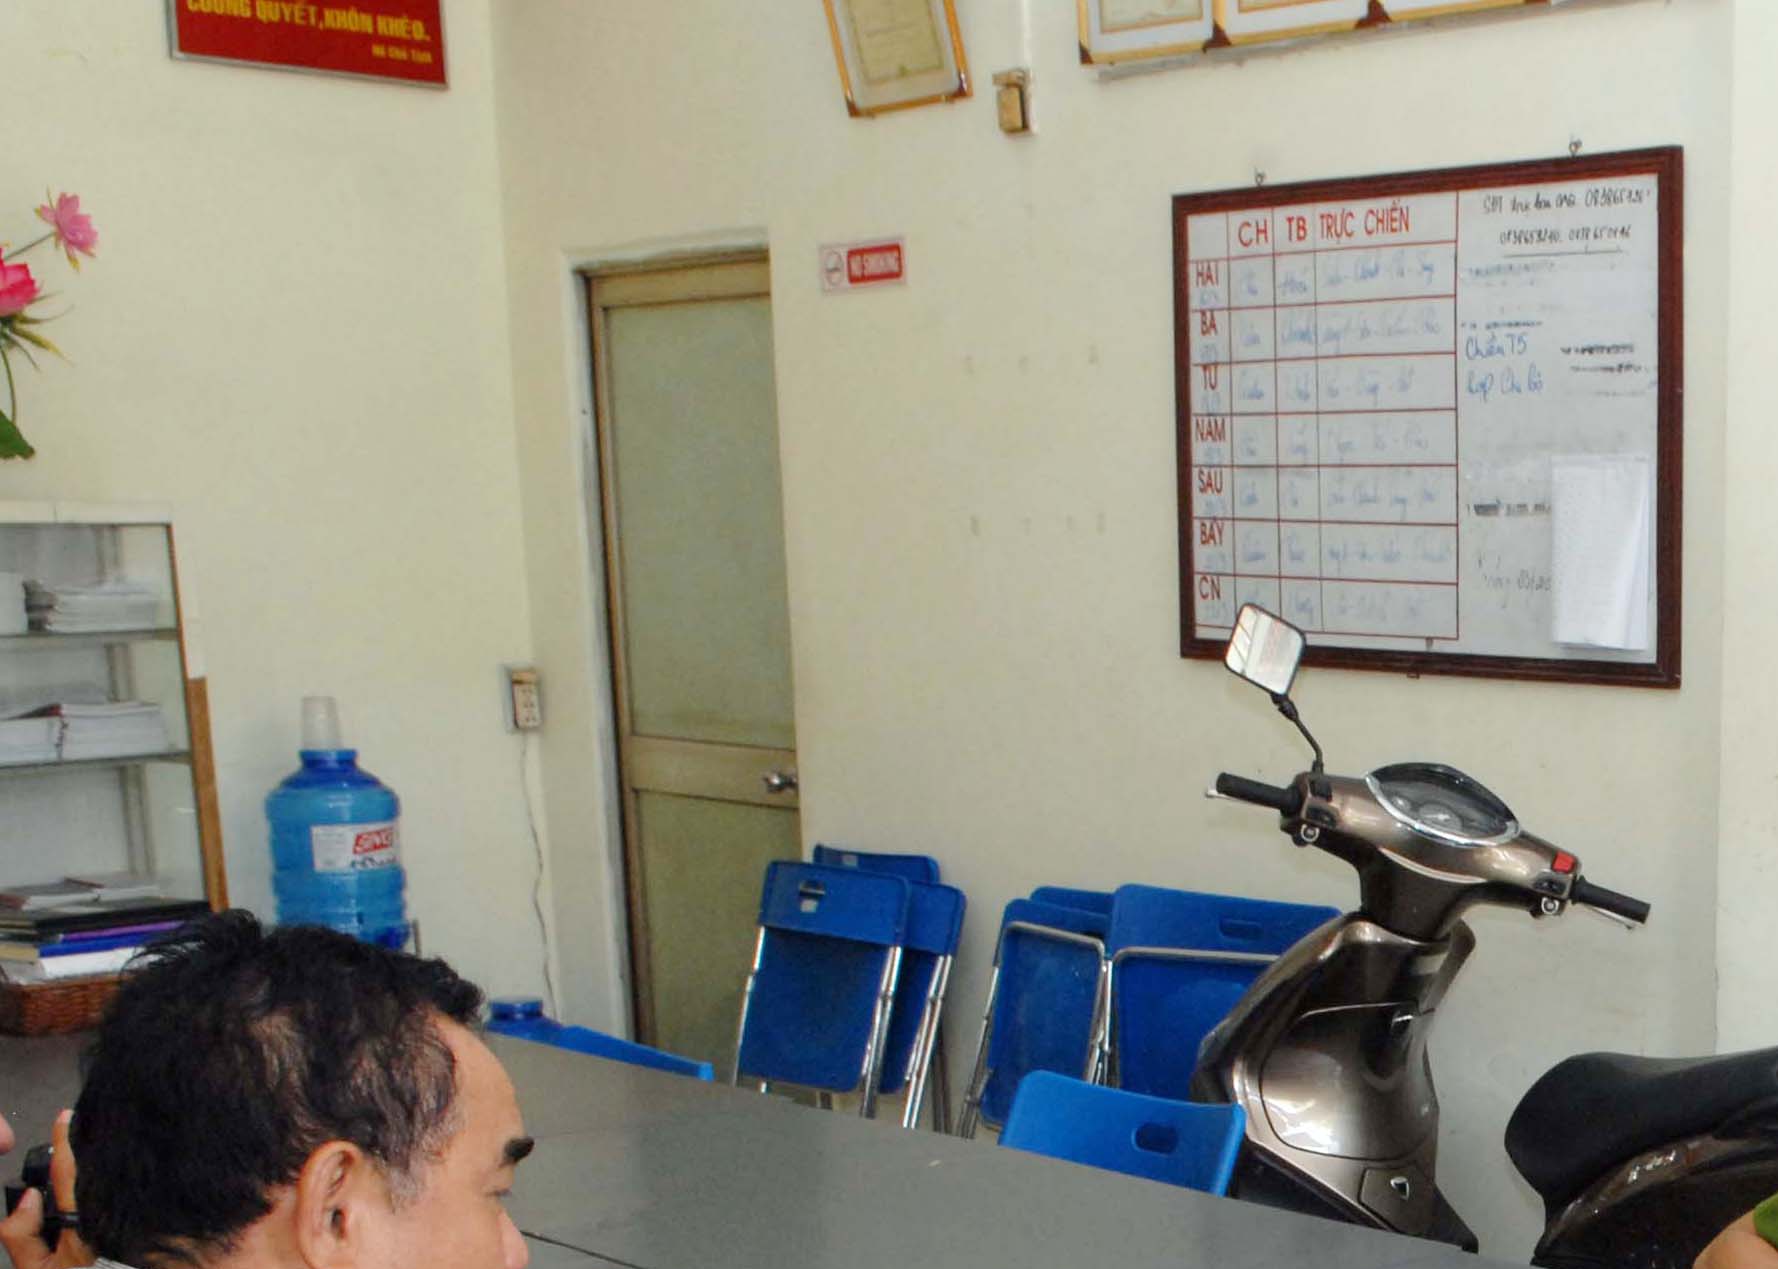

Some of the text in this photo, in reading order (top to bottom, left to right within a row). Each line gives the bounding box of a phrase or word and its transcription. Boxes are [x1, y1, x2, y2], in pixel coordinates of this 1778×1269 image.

[1238, 200, 1411, 248] CH TB TRỰC CHIẾN
[1196, 262, 1220, 288] HAI
[1200, 311, 1217, 337] BA
[1199, 576, 1222, 600] CN
